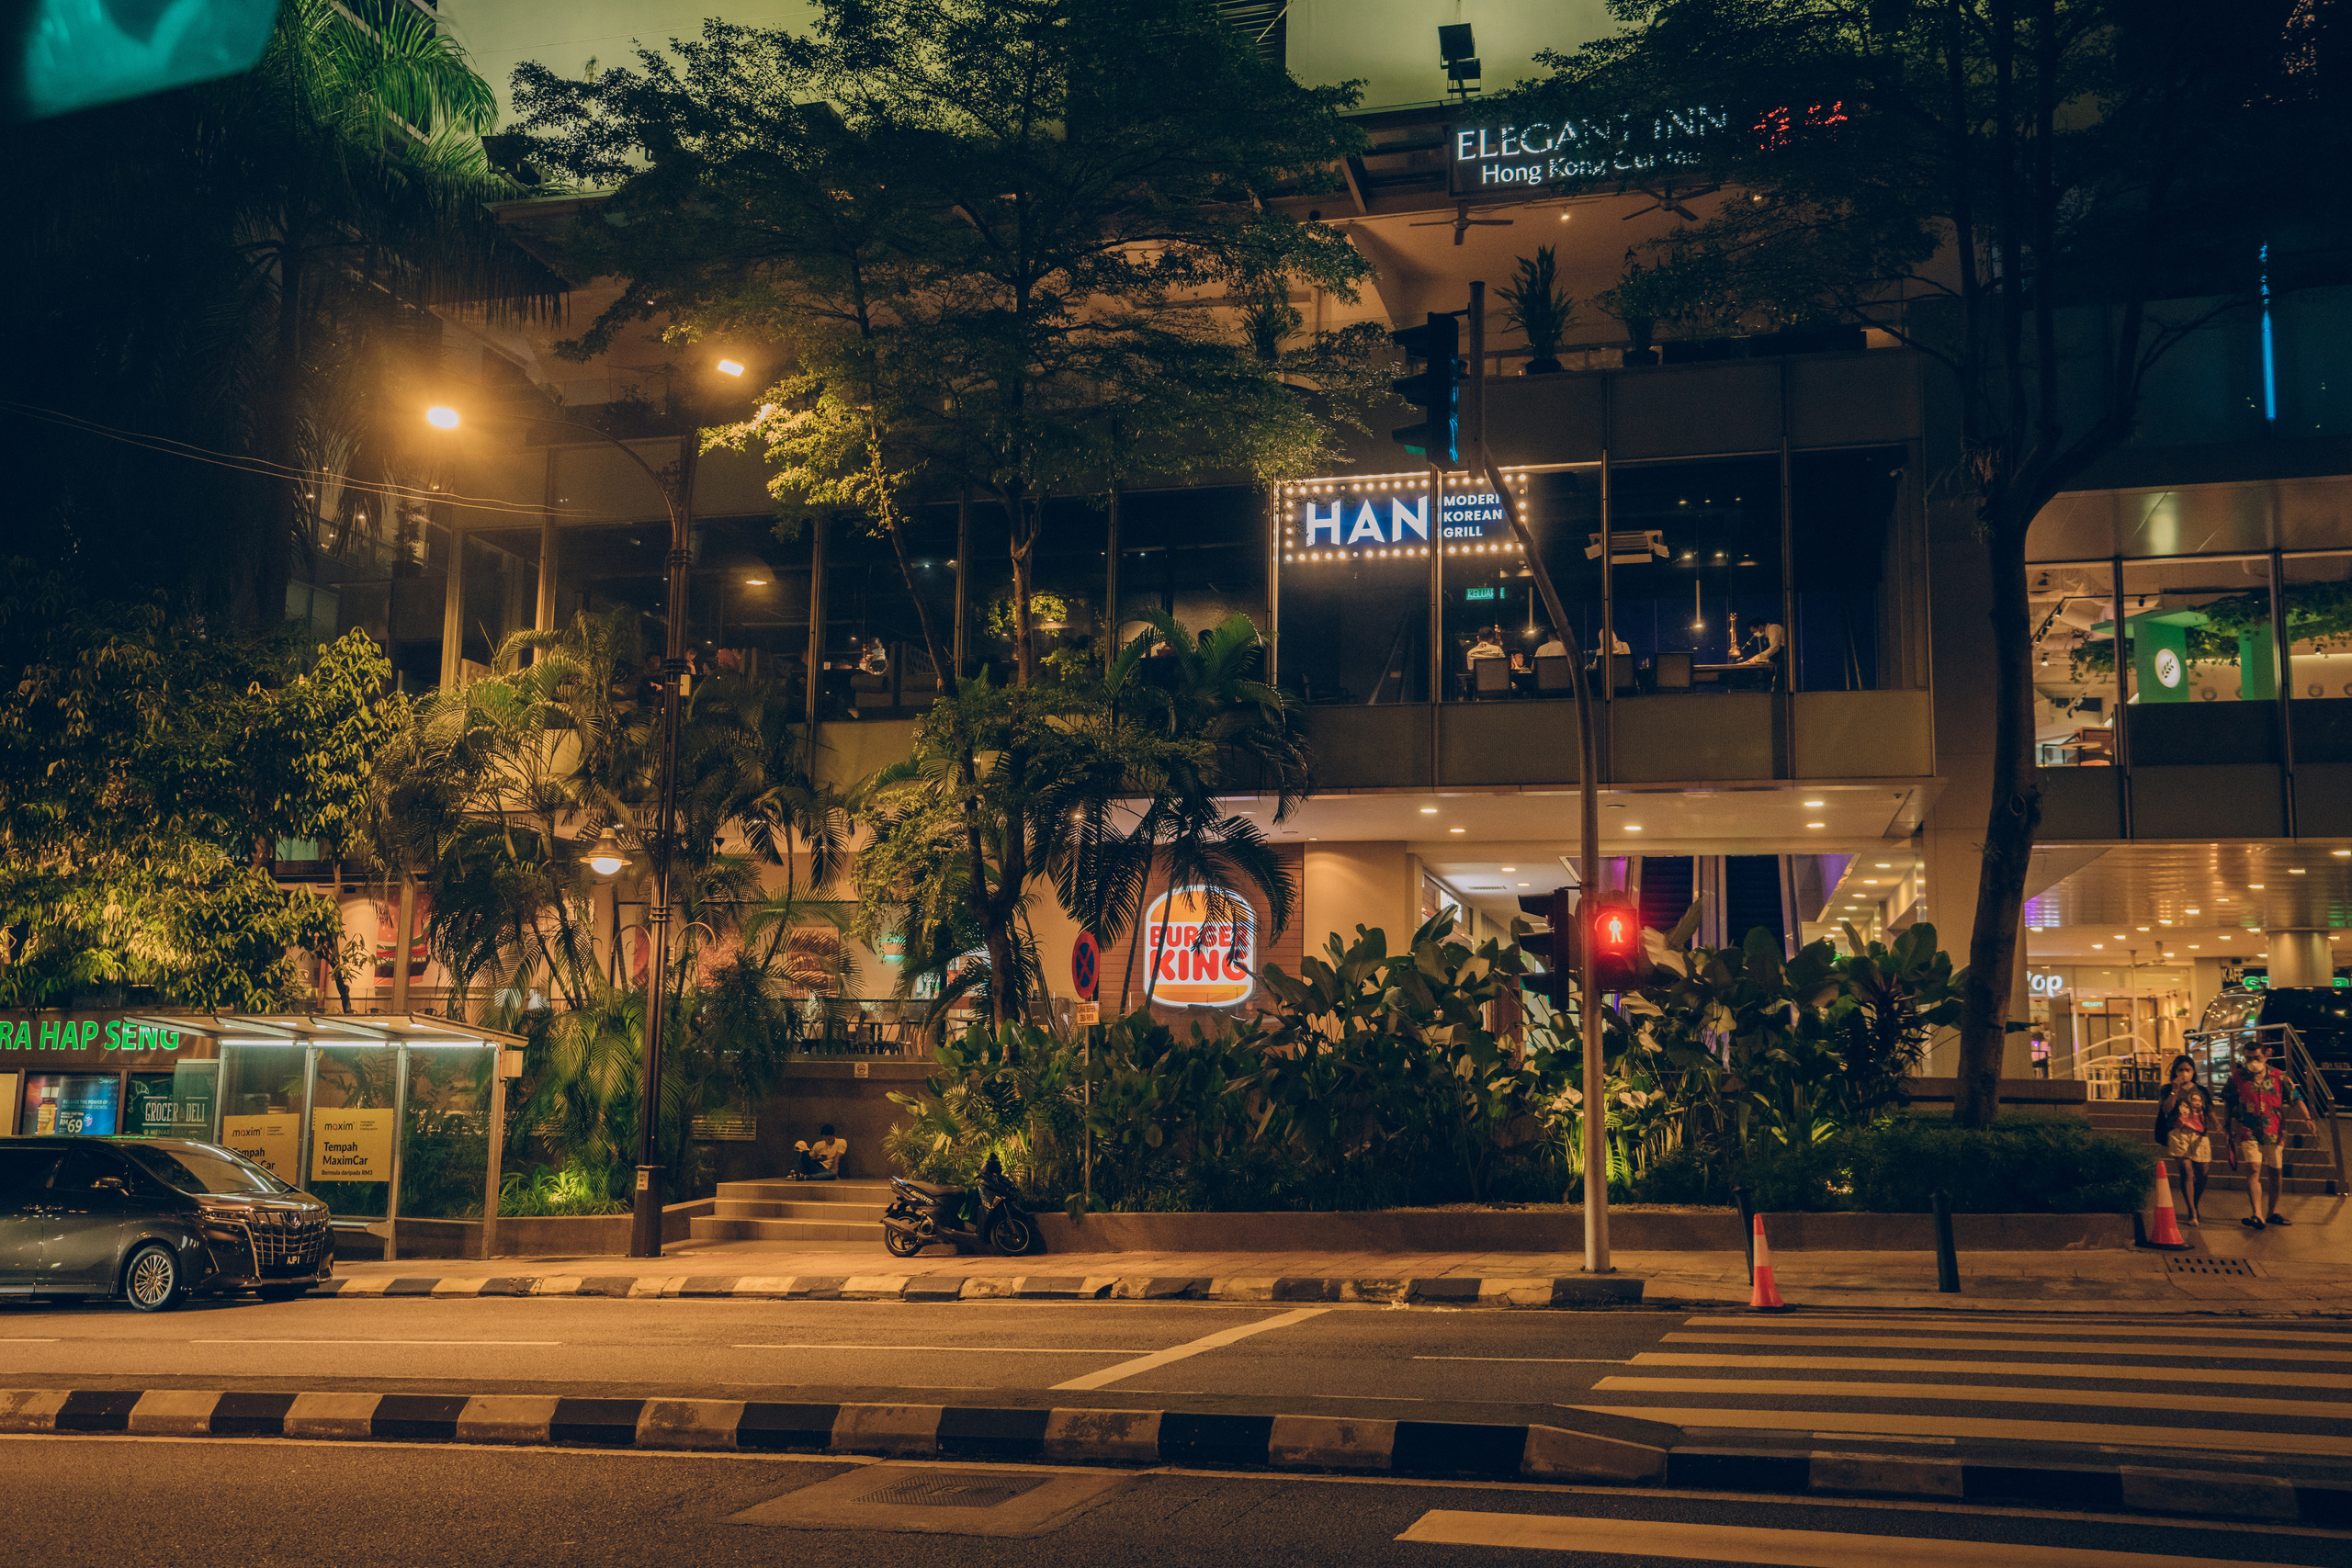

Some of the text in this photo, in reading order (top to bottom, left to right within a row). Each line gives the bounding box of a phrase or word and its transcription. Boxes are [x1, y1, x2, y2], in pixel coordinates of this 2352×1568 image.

[1481, 164, 1543, 186] Hong
[1306, 495, 1428, 547] HAN
[1443, 509, 1503, 523] KOREAN
[1443, 525, 1483, 538] GRILL
[1150, 925, 1250, 947] BURGER
[1149, 949, 1249, 981] KING
[2222, 967, 2245, 982] KAFE
[40, 1021, 99, 1050] HAP
[104, 1020, 180, 1051] SENG
[145, 1102, 179, 1122] GROCER
[186, 1102, 205, 1122] DELI
[232, 1127, 261, 1137] maxim
[324, 1121, 354, 1131] maxim
[323, 1142, 357, 1154] Tempah
[322, 1155, 368, 1165] MaximCar
